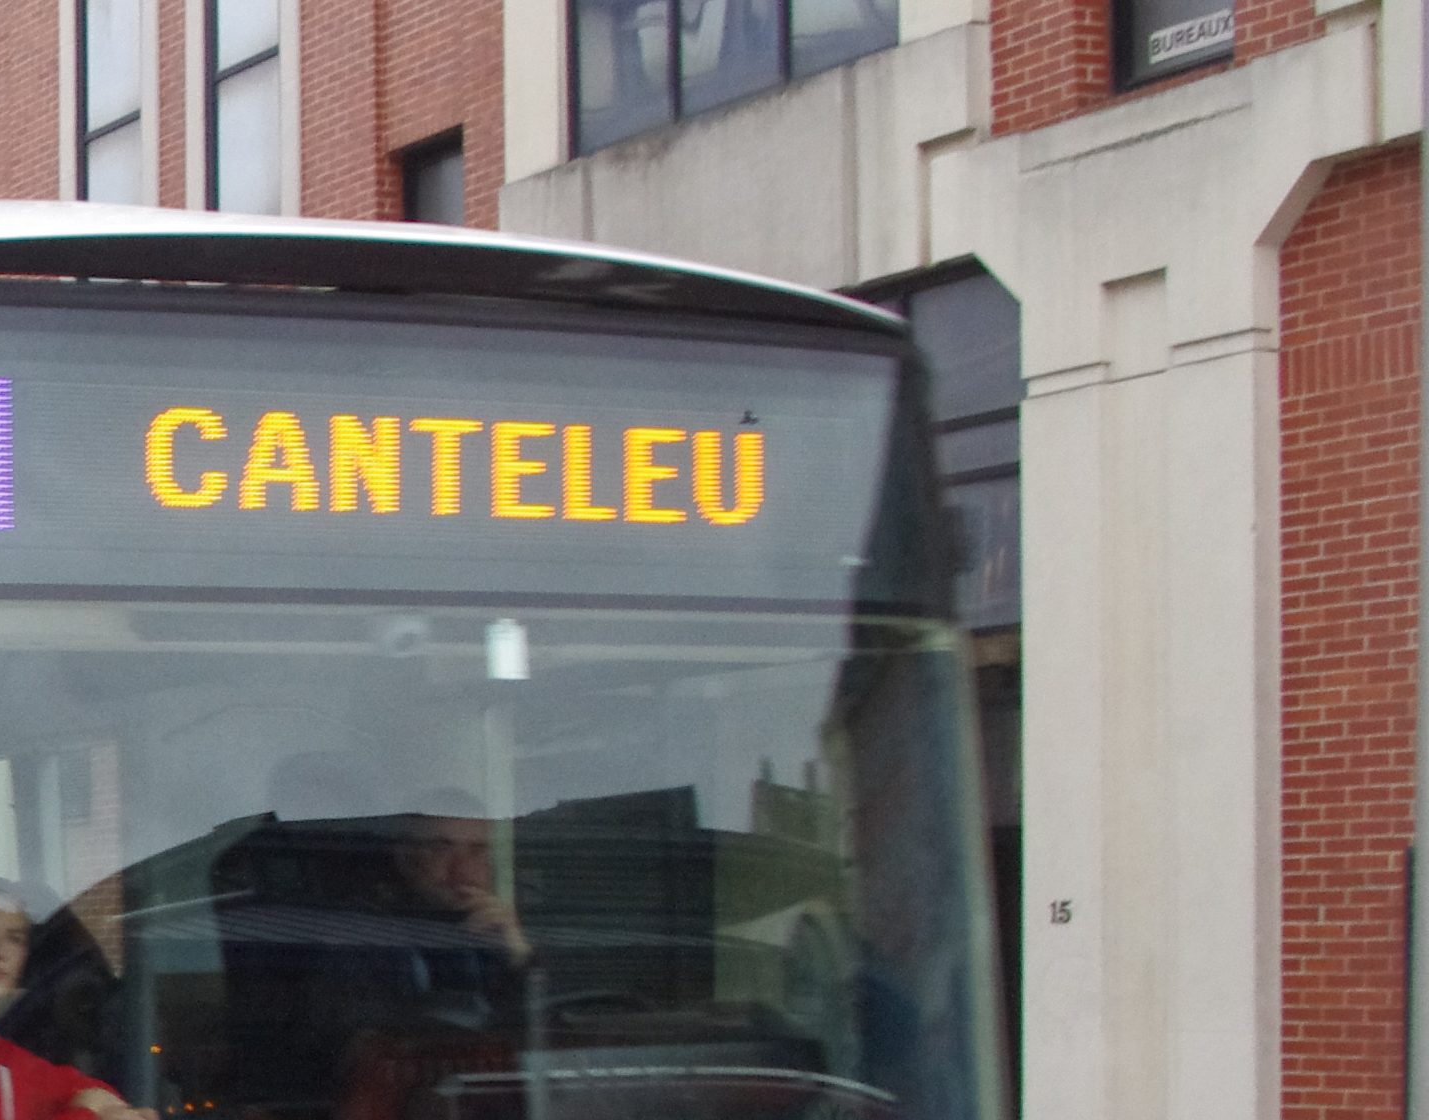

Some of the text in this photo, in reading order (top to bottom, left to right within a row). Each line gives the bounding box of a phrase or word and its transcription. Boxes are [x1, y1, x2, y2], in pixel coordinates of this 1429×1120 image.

[1150, 14, 1232, 57] BUREAUX
[144, 406, 764, 525] CANTELEU
[1050, 899, 1073, 924] 15
